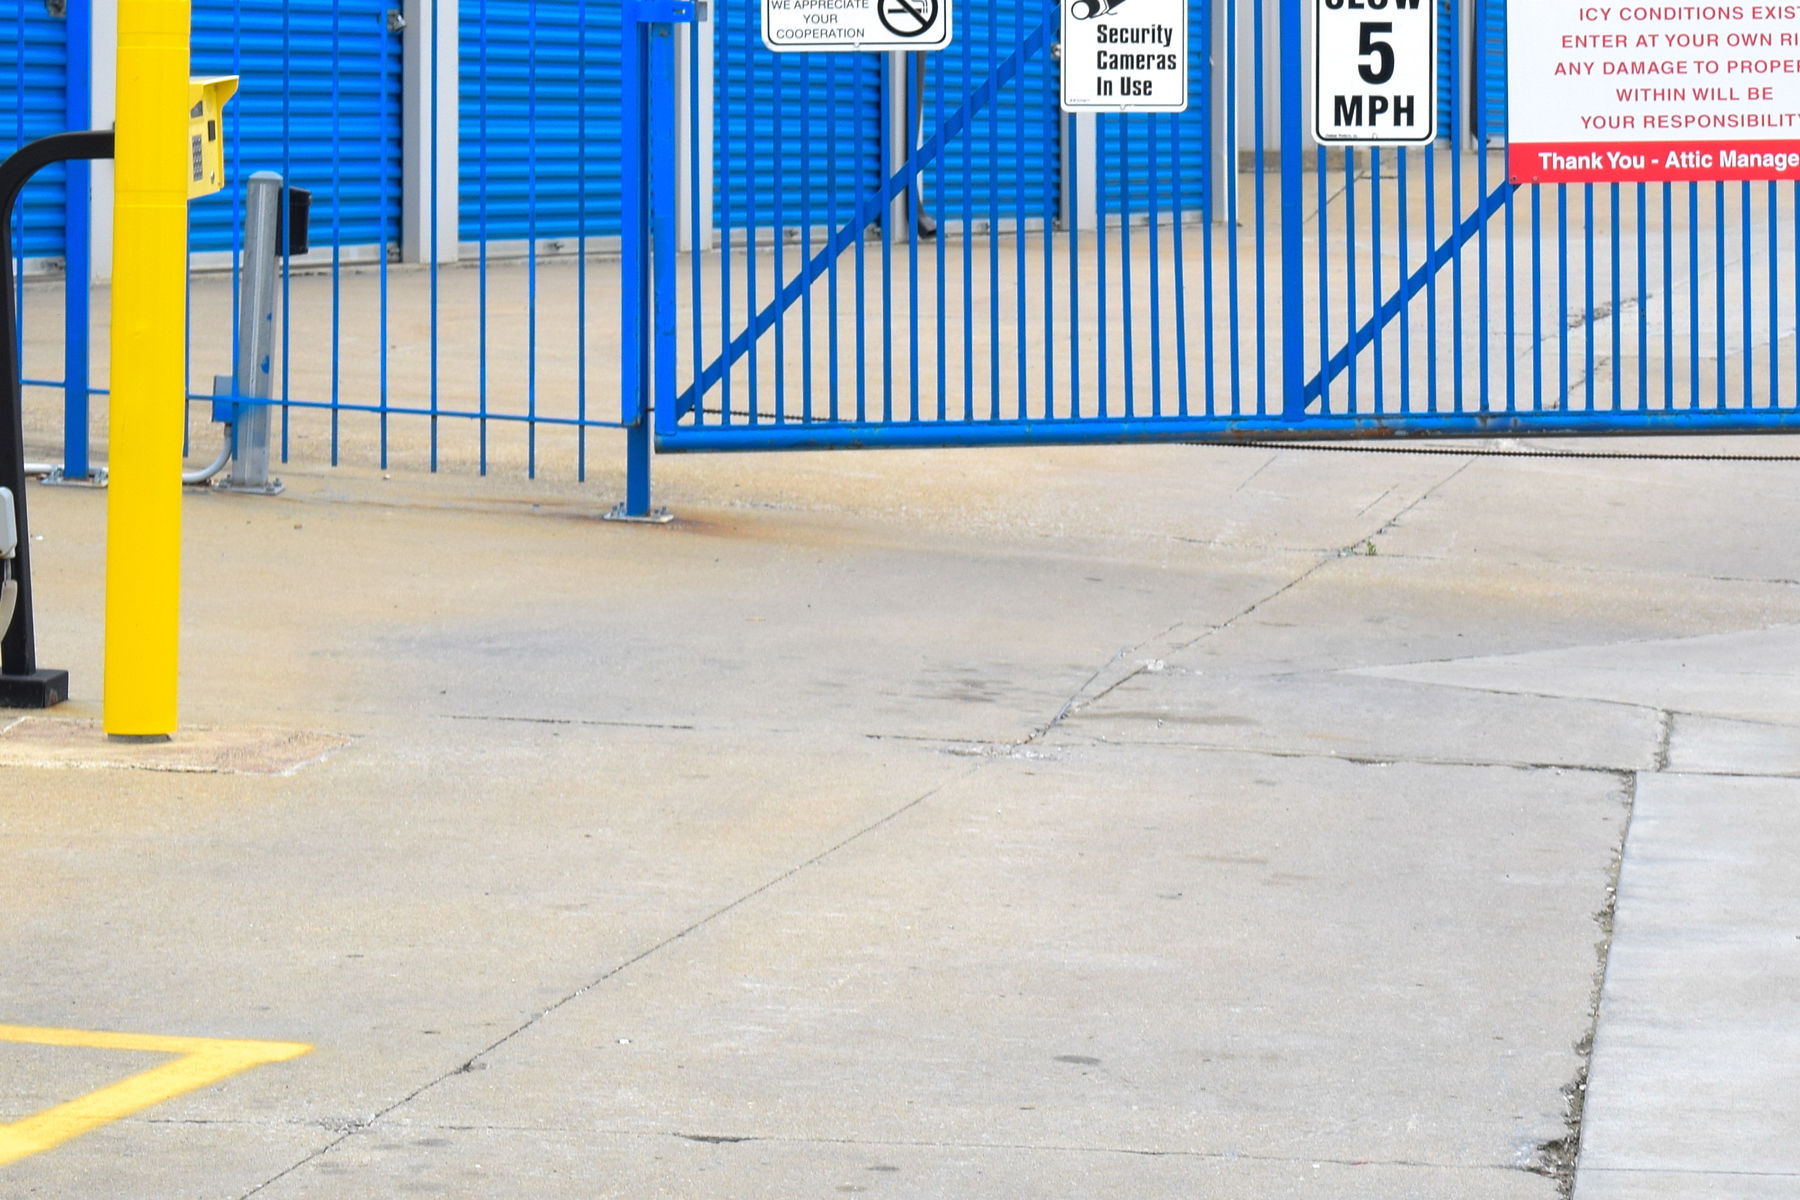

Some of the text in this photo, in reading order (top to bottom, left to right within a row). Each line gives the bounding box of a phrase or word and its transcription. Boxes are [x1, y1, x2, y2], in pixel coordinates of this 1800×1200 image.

[771, 0, 869, 10] WE APPRECIATE
[803, 14, 838, 24] YOUR
[1578, 8, 1611, 22] ICY
[1619, 6, 1744, 21] CONDITIONS
[776, 28, 865, 39] COOPERATION
[1097, 24, 1173, 47] Security
[1561, 35, 1628, 49] ENTER
[1636, 34, 1660, 48] AT
[1665, 33, 1719, 48] YOUR
[1726, 33, 1773, 47] OWN
[1097, 50, 1176, 70] Cameras
[1358, 21, 1395, 85] 5
[1554, 62, 1595, 76] ANY
[1603, 61, 1687, 76] DAMAGE
[1693, 60, 1720, 74] TO
[1097, 77, 1152, 96] In Use
[1616, 87, 1774, 102] WITHIN WILL BE
[1334, 95, 1414, 127] MPH
[1581, 115, 1636, 130] YOUR
[1538, 153, 1603, 170] Thank
[1606, 152, 1645, 170] You
[1665, 151, 1712, 168] Attic
